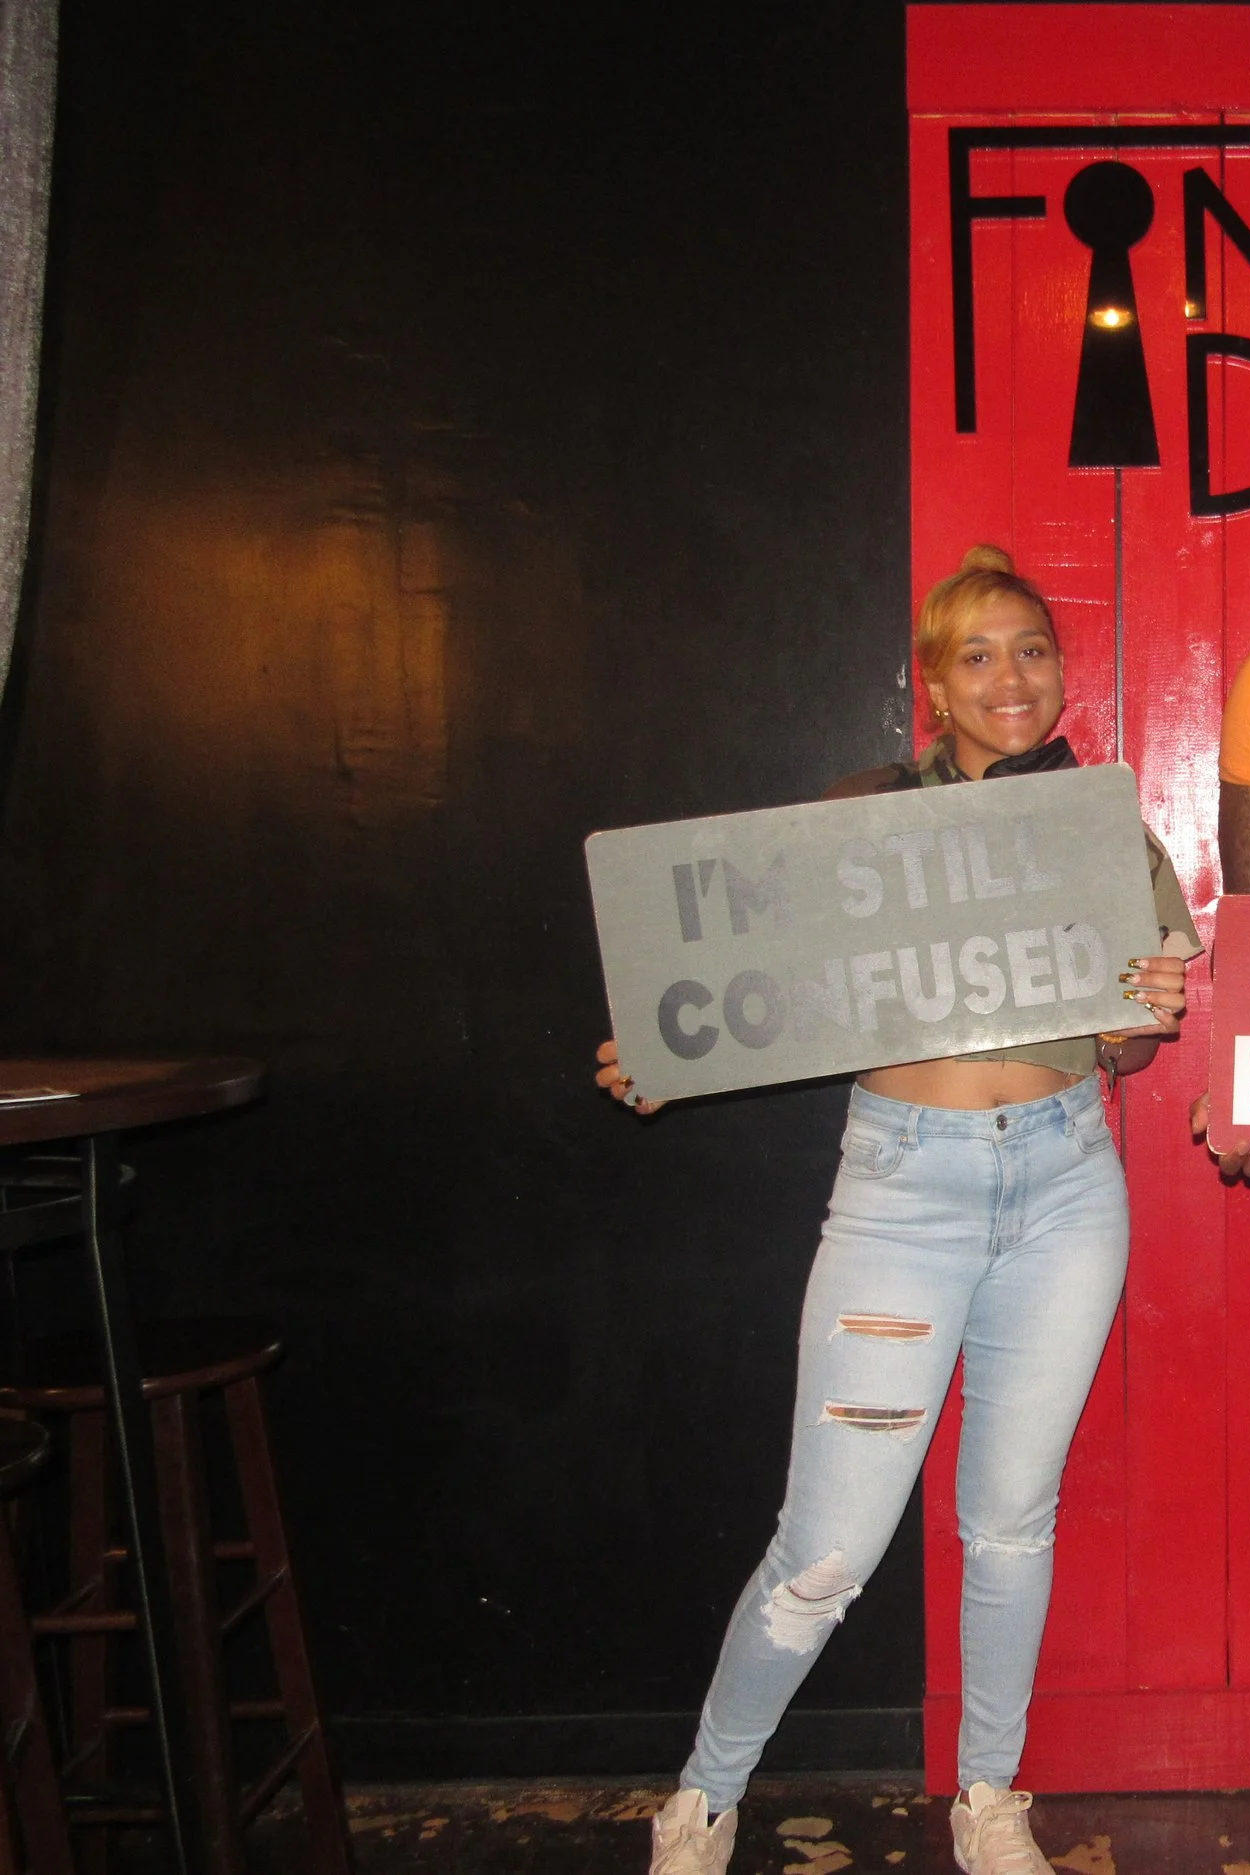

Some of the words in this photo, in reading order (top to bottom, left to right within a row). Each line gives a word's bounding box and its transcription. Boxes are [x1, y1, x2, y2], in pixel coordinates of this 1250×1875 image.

[672, 851, 793, 943] I'M
[835, 820, 1064, 919] STILL
[657, 921, 1111, 1061] CONFUSED
